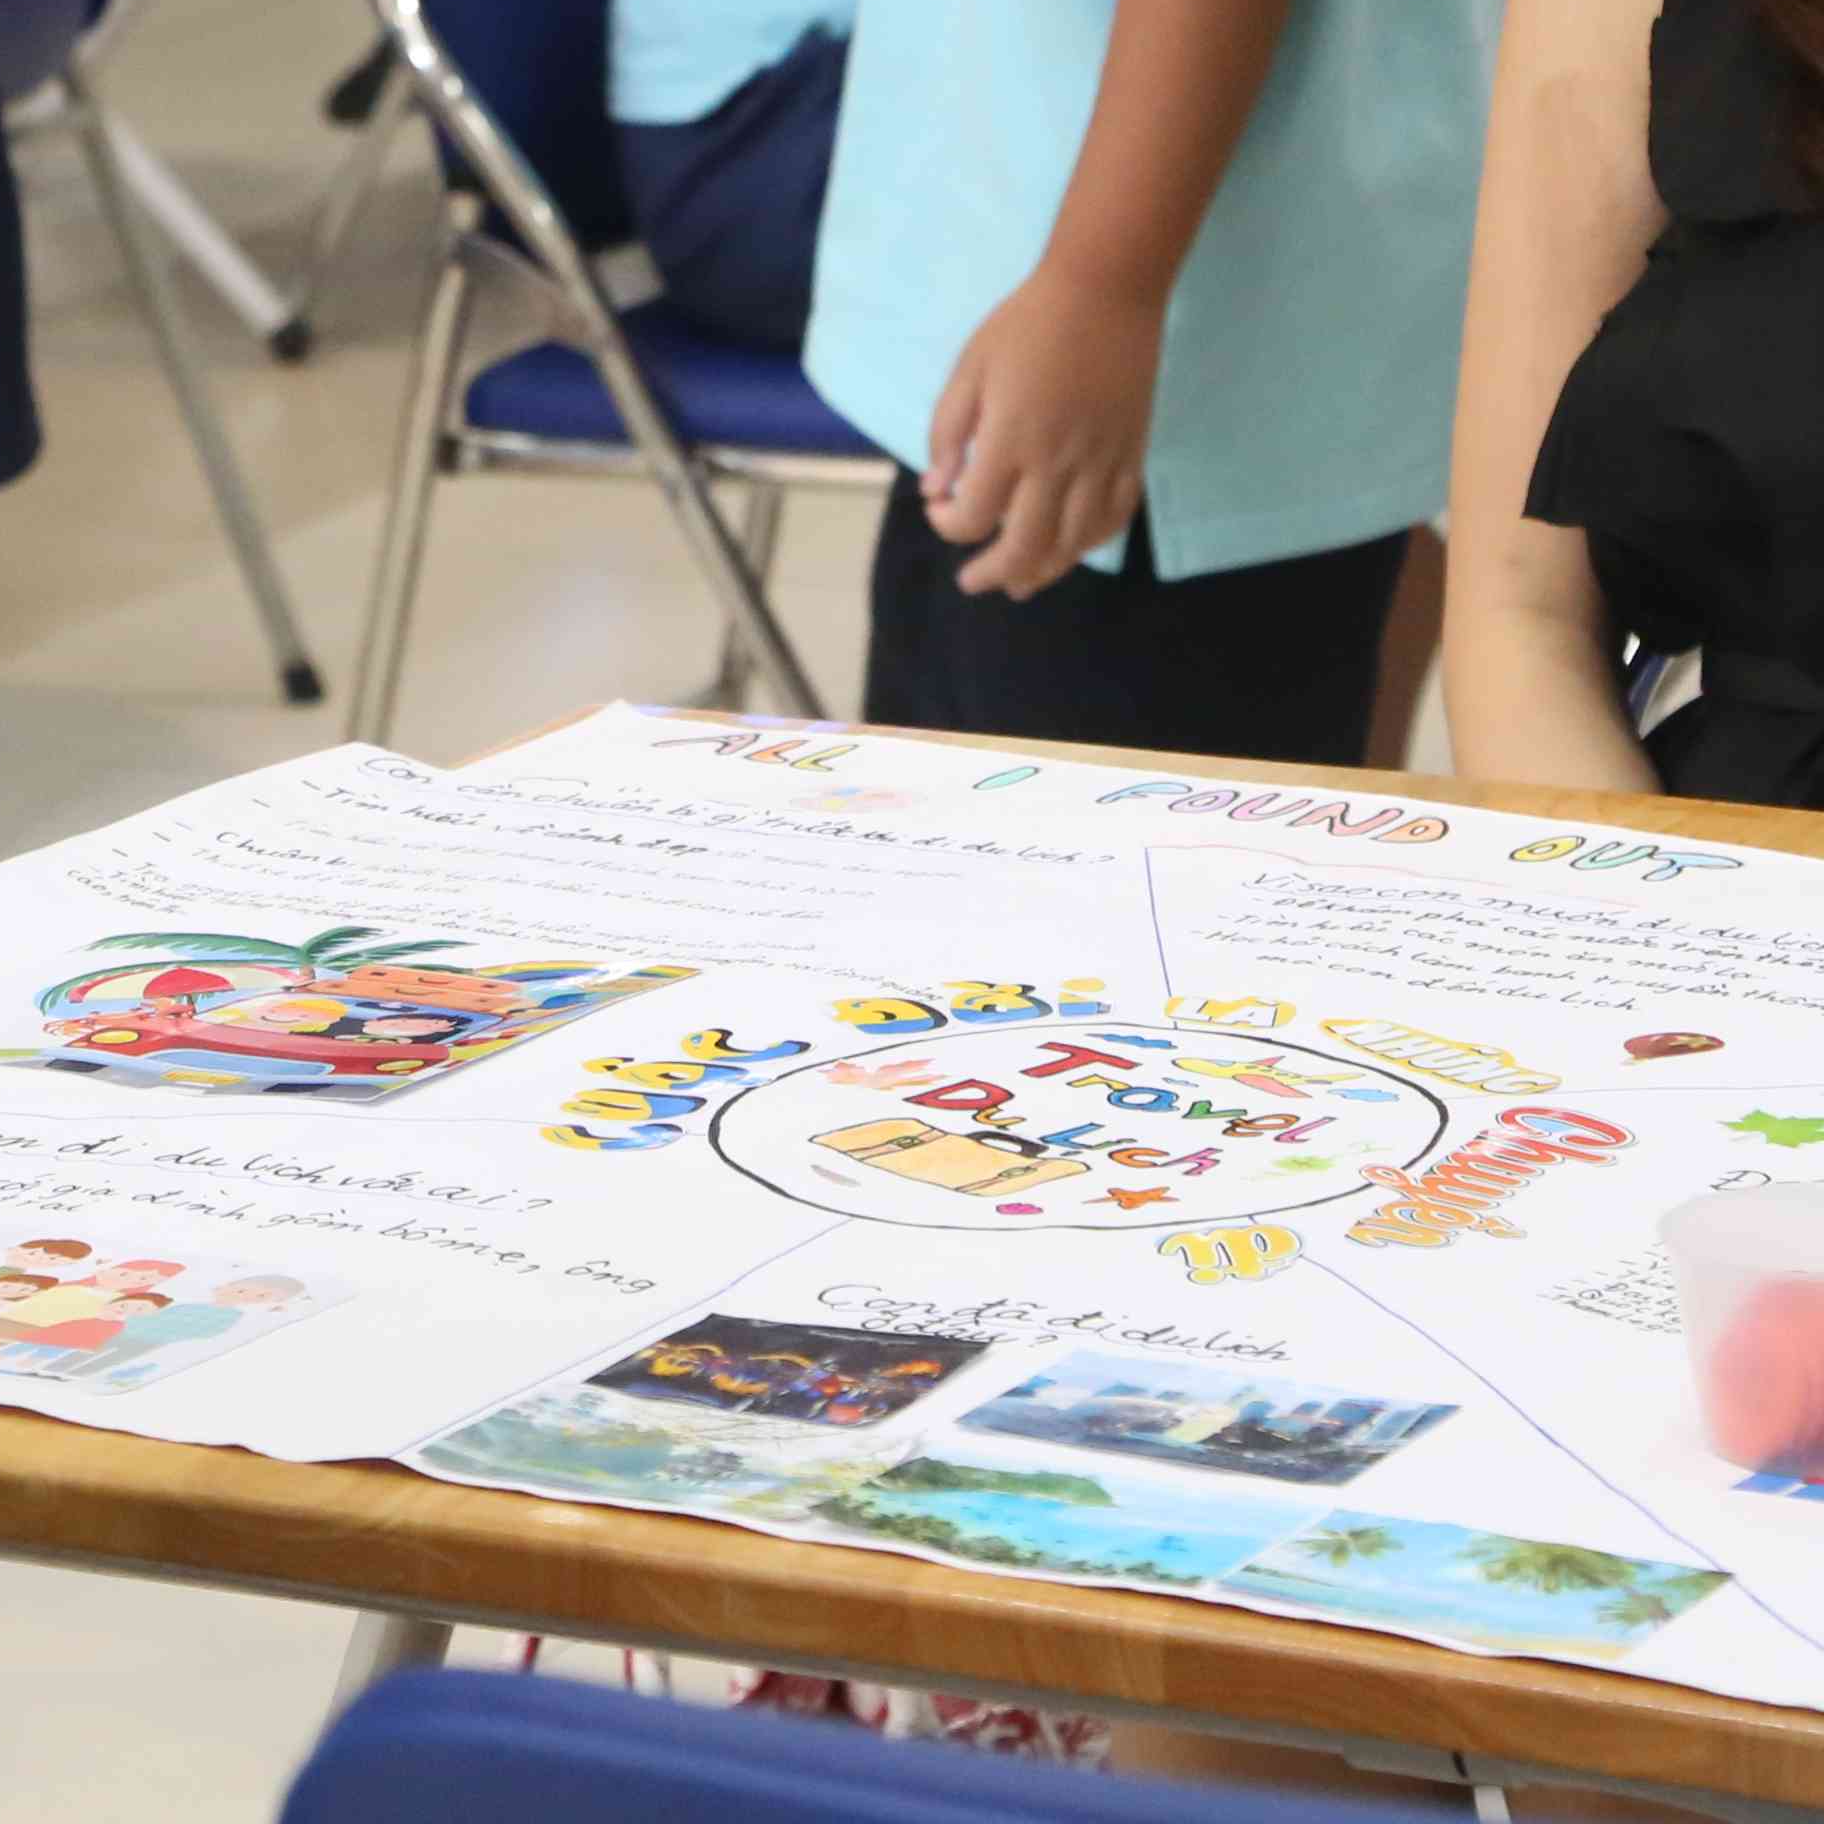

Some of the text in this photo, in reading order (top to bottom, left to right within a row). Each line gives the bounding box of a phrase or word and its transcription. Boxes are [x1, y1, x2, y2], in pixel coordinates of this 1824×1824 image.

[651, 732, 860, 772] ALL
[1094, 781, 1450, 844] FOUND
[1508, 834, 1744, 882] OUT
[1018, 1040, 1339, 1144] Travel
